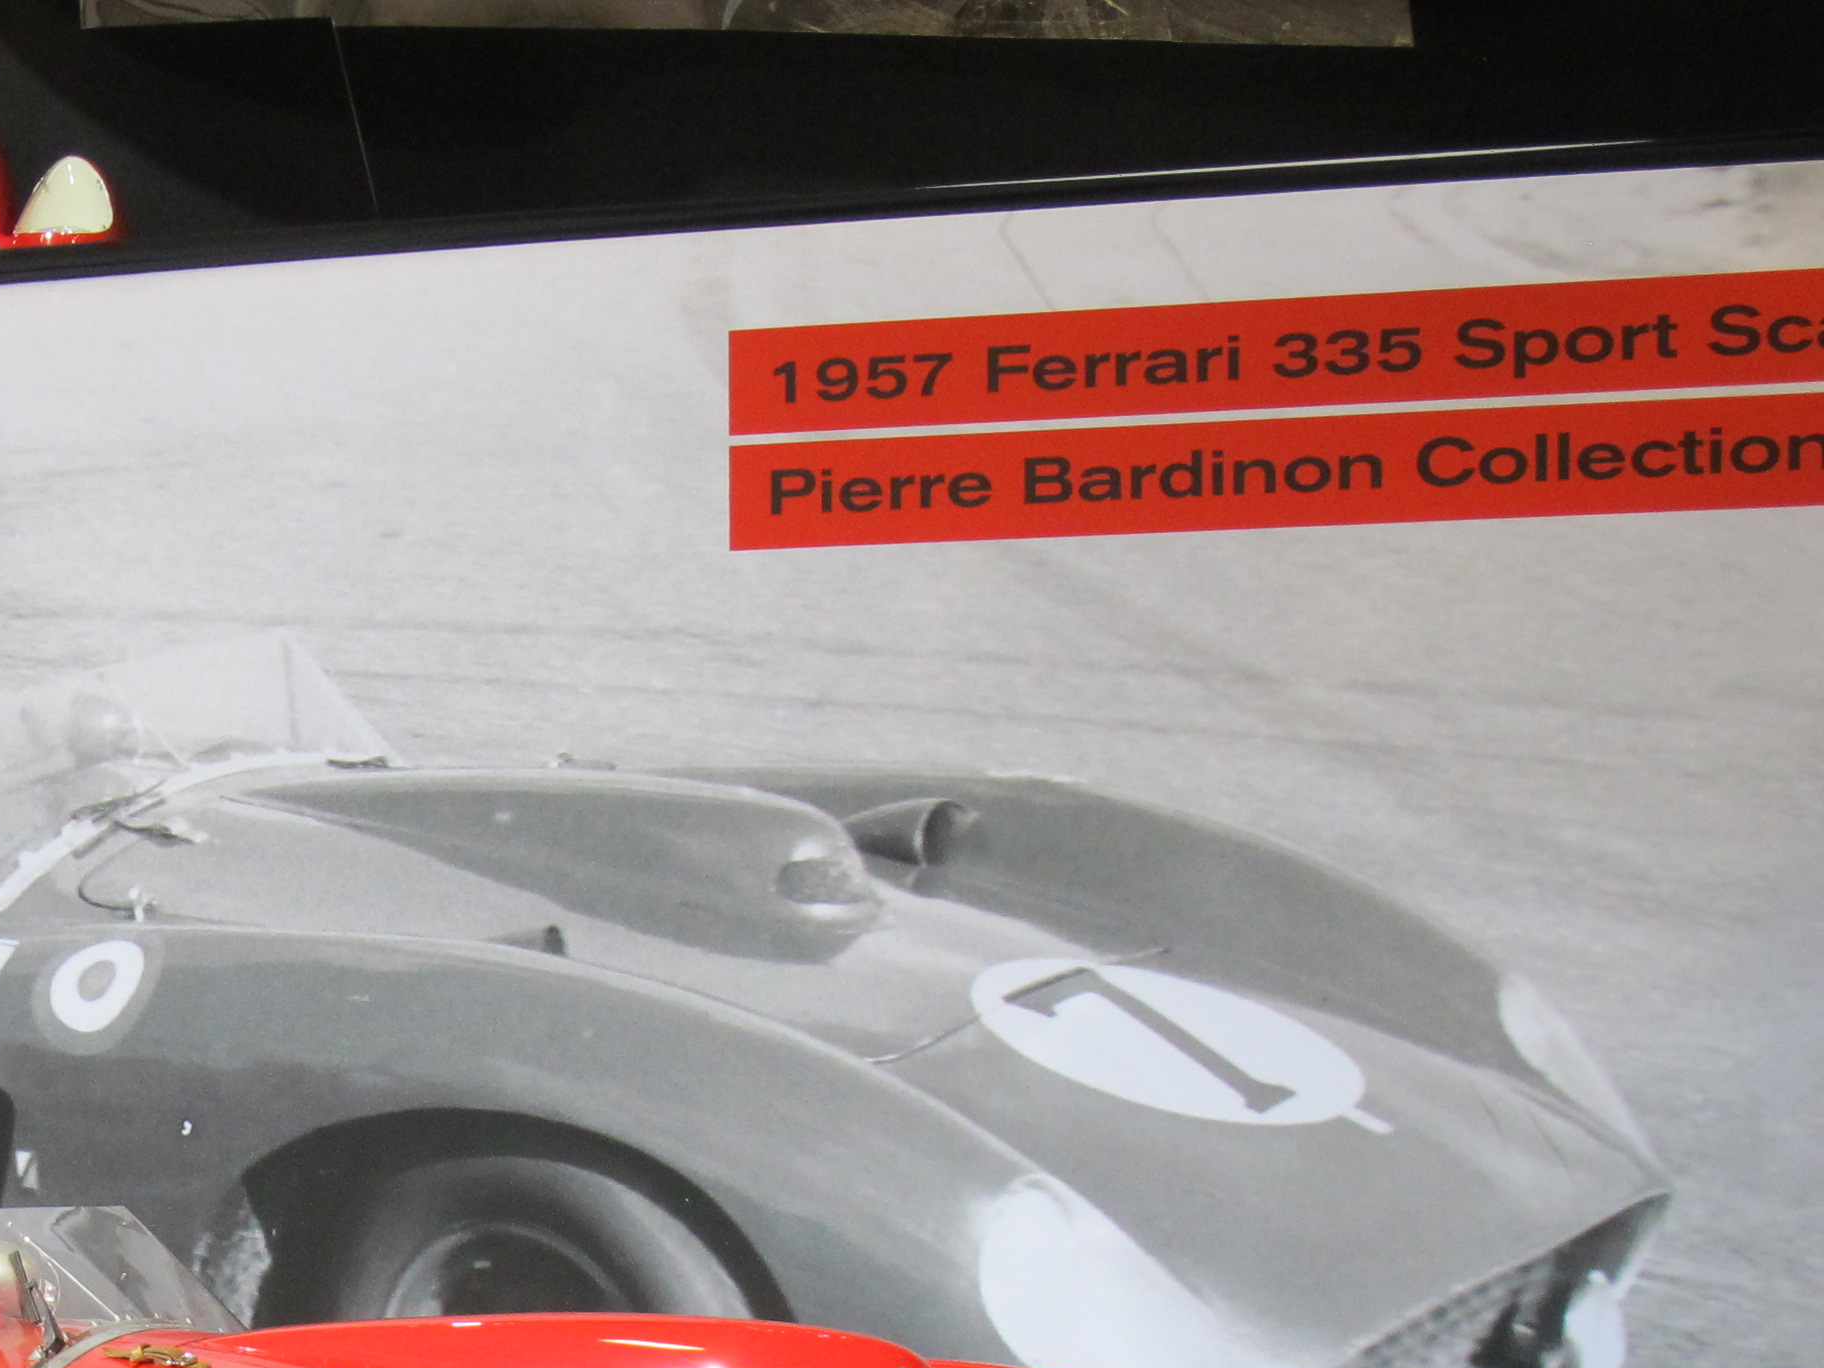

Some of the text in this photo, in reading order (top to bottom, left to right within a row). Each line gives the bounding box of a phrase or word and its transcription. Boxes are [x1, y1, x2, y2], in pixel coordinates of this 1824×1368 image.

[773, 305, 1824, 405] 1957 Ferrari 335 Sport Sc
[770, 426, 1824, 517] Pierre Bardinon Collection
